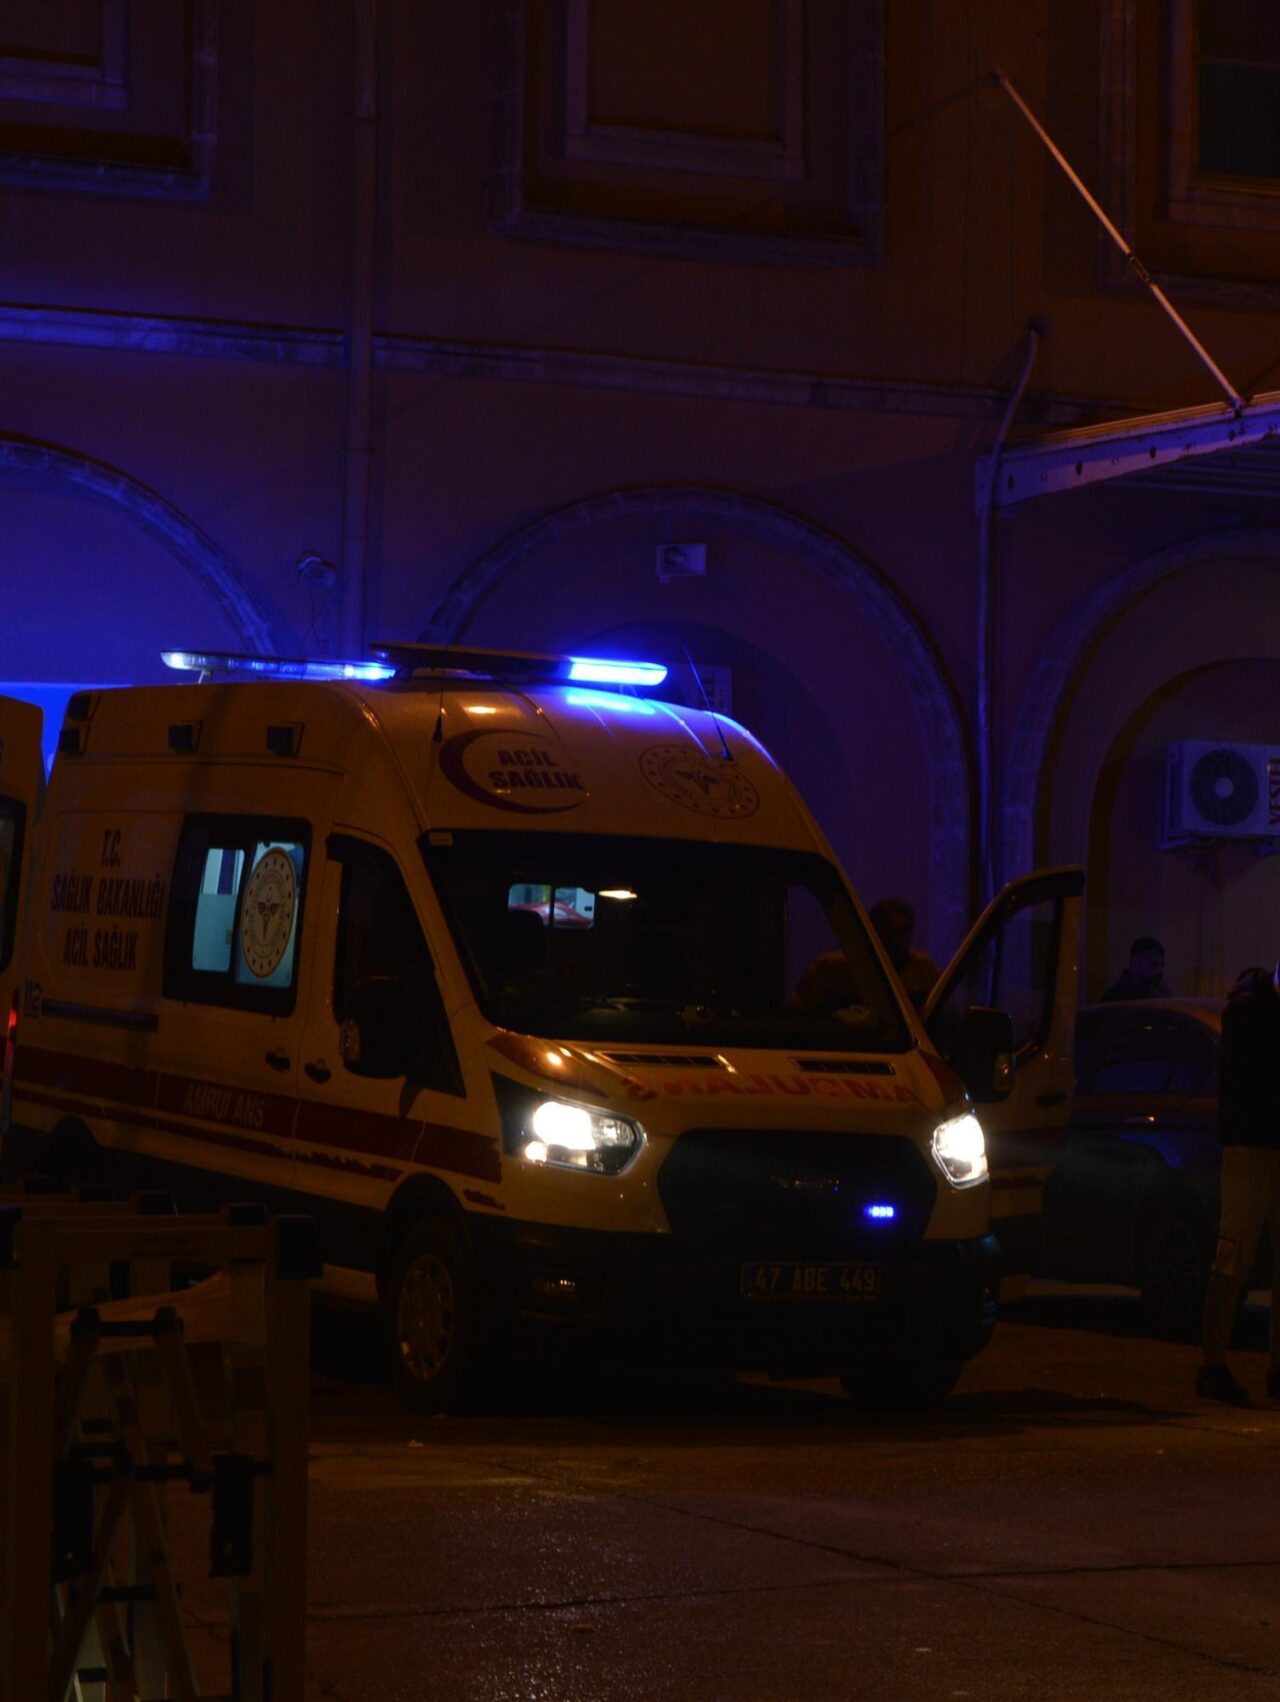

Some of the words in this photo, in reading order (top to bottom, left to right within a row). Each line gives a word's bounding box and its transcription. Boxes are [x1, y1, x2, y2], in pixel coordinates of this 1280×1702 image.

[489, 768, 585, 790] SAĞLIK
[101, 828, 121, 869] T.C.
[51, 869, 94, 915] SAĞLIK
[97, 874, 165, 920] BAKANLIĞI
[93, 921, 139, 972] SAĞLIK
[754, 1265, 782, 1292] 47
[791, 1266, 829, 1293] ABE
[839, 1266, 876, 1293] 449
